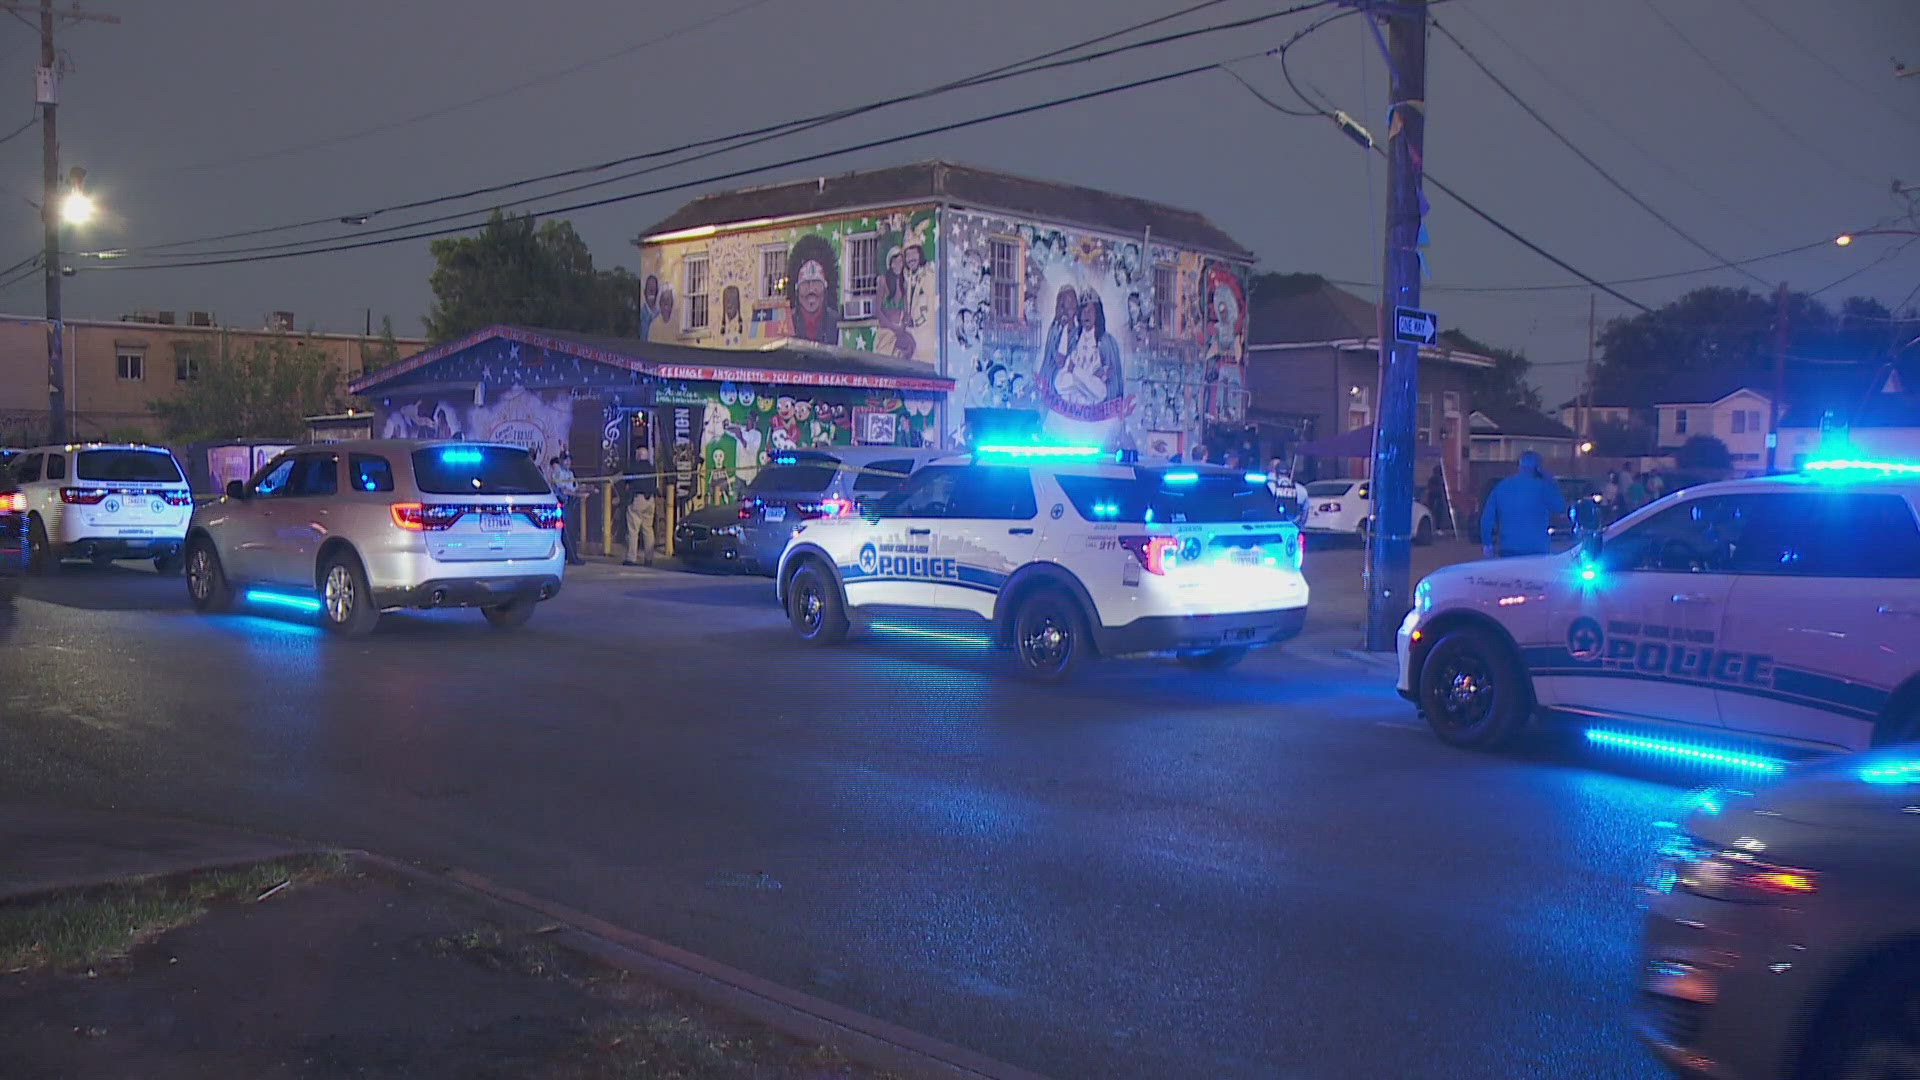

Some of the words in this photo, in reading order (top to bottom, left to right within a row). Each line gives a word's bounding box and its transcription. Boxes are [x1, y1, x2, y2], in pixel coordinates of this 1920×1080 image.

[1400, 317, 1413, 332] ONE
[1414, 319, 1425, 335] WAY
[660, 367, 703, 378] TEENAGE
[818, 374, 848, 386] BREAK
[1099, 541, 1117, 551] 911
[879, 555, 957, 580] POLICE
[1605, 637, 1775, 689] POLICE
